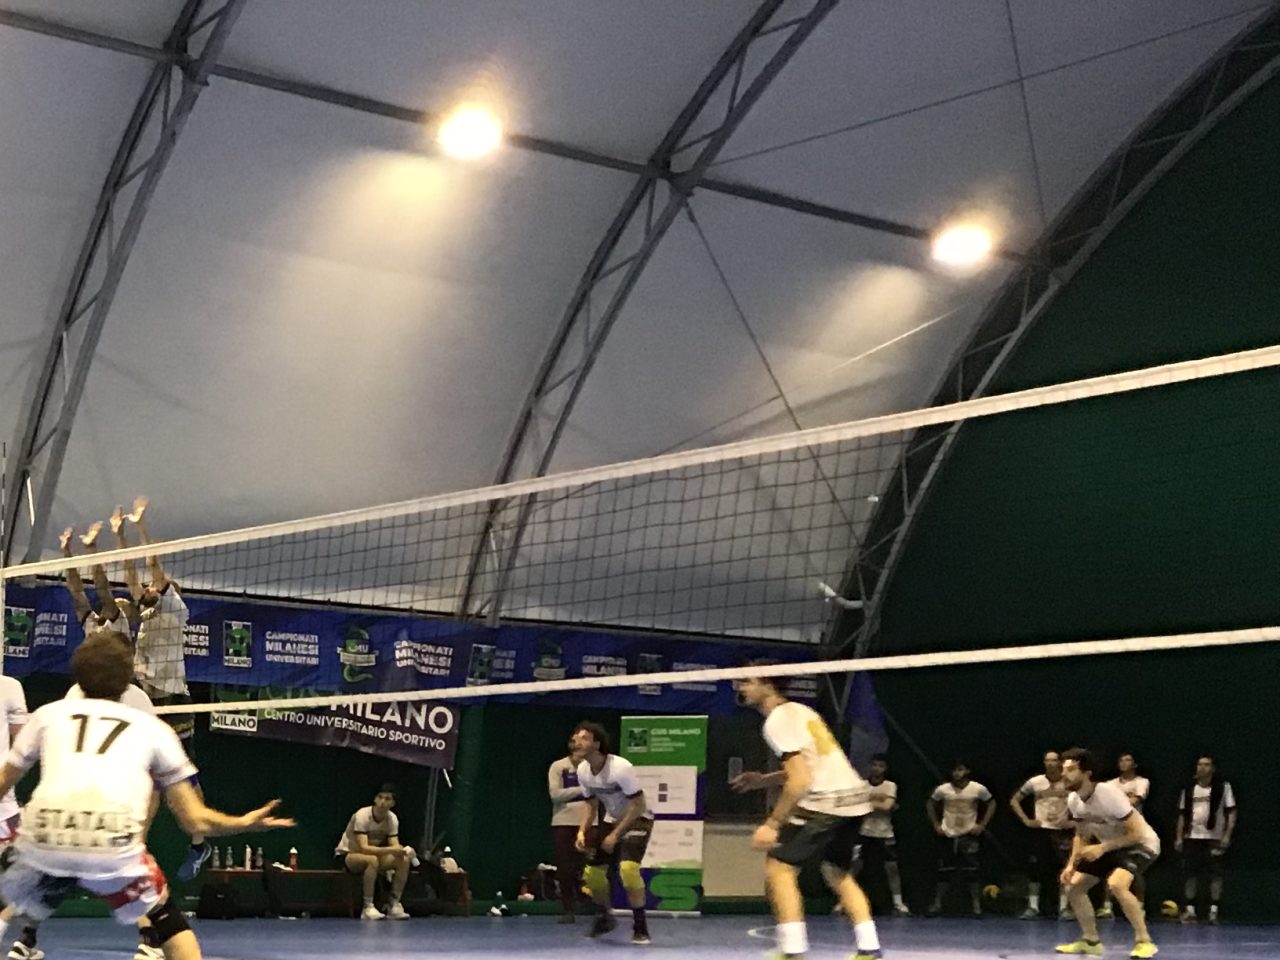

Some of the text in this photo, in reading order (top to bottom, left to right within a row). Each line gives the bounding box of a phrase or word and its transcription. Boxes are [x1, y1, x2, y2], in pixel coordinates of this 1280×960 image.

[183, 635, 210, 647] NESI
[265, 631, 319, 643] CAMPIONATI
[265, 642, 319, 655] MILANESI
[266, 654, 319, 666] UNIVERSITARI
[212, 714, 257, 729] MILANO
[69, 713, 131, 755] 17
[263, 708, 447, 751] CENTRO UNIVERSITARIO SPORTIVO
